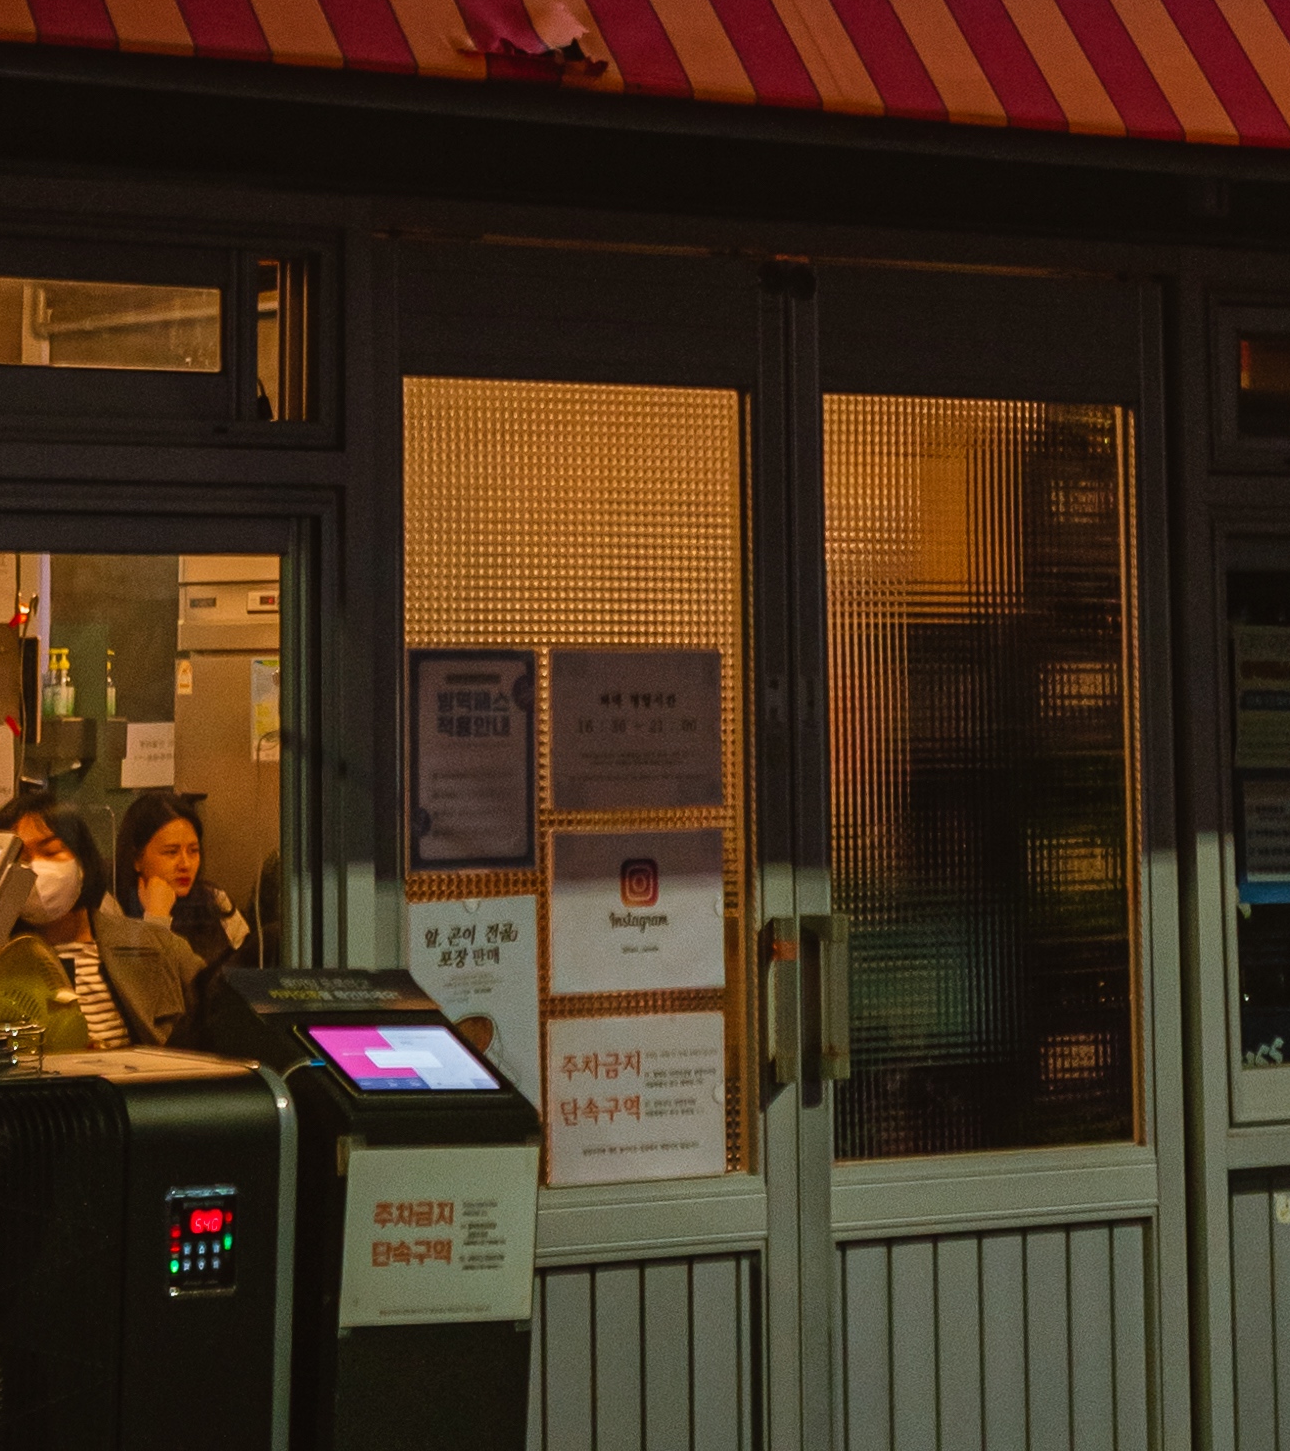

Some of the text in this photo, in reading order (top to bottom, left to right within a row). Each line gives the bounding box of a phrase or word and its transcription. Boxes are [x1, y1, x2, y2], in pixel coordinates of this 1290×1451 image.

[436, 691, 510, 712] 방역패스
[436, 715, 511, 737] 적용안내
[609, 912, 669, 933] Instagram
[448, 924, 476, 947] 곤이
[437, 946, 499, 968] 포장 판매
[560, 1050, 641, 1081] 주차금지
[560, 1095, 641, 1126] 단속구역
[373, 1201, 455, 1228] 주차금지
[371, 1240, 453, 1267] 단속구역
